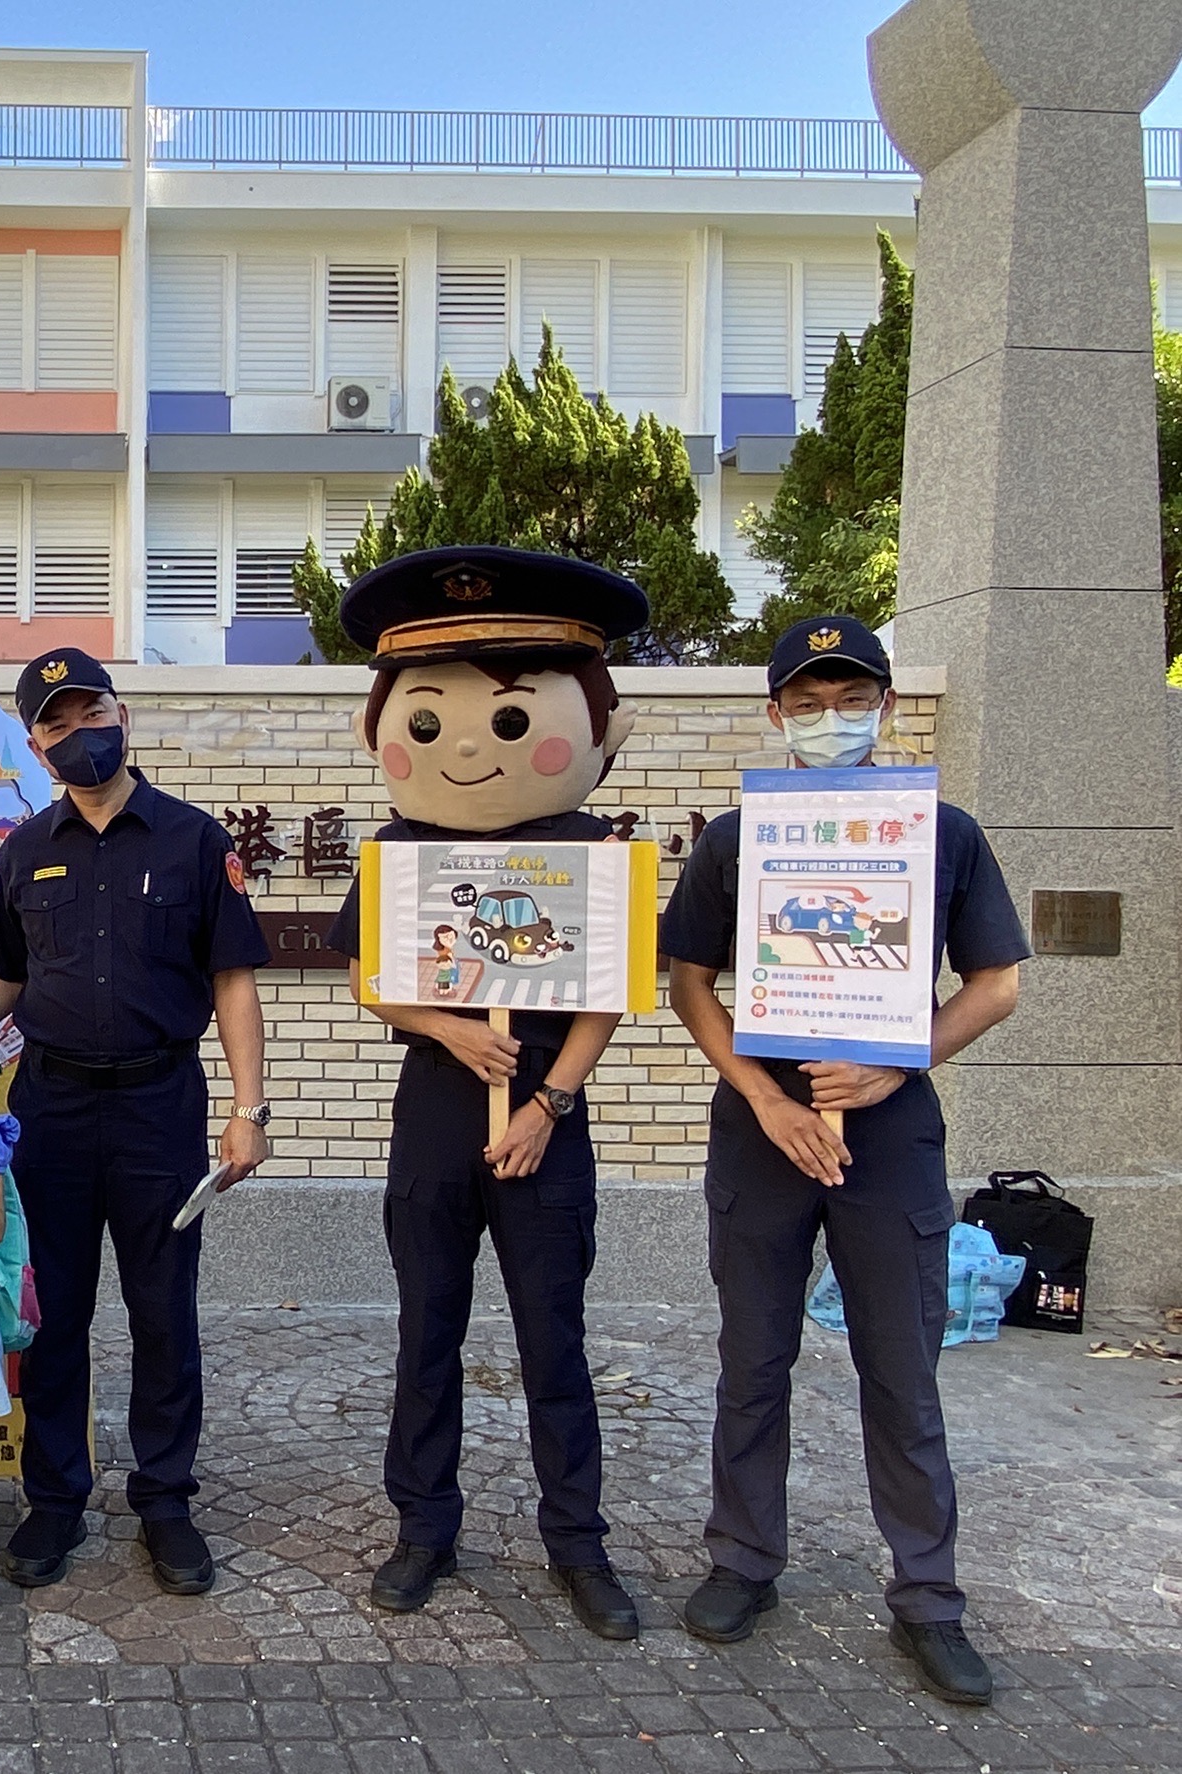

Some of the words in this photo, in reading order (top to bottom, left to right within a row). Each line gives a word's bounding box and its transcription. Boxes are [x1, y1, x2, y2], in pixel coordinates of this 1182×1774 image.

[756, 819, 906, 845] 路口慢看停
